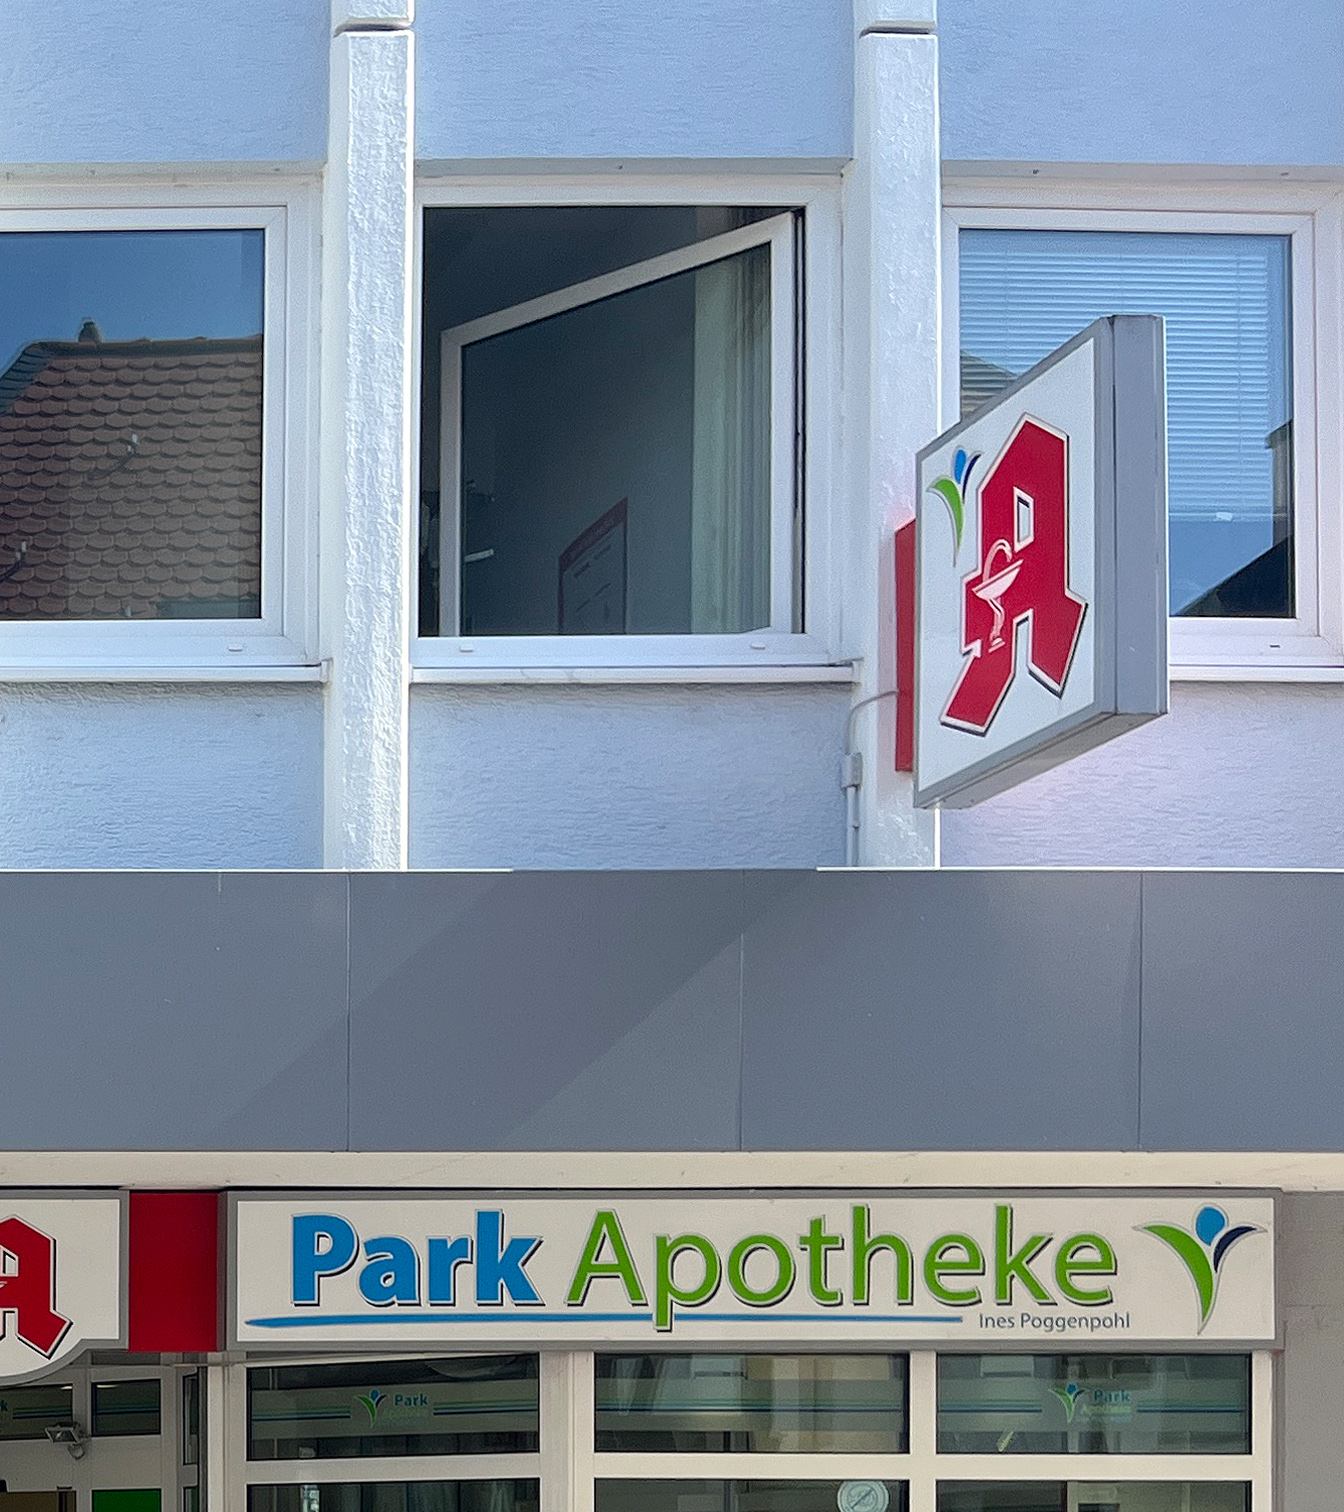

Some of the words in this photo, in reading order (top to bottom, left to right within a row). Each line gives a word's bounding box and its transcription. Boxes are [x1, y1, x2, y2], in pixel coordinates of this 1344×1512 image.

[290, 1210, 543, 1308] Park
[565, 1205, 1118, 1332] Apotheke
[980, 1313, 1015, 1328] Ines
[1021, 1312, 1130, 1332] Poggenpohl
[394, 1393, 428, 1406] Park
[1093, 1389, 1131, 1402] Park
